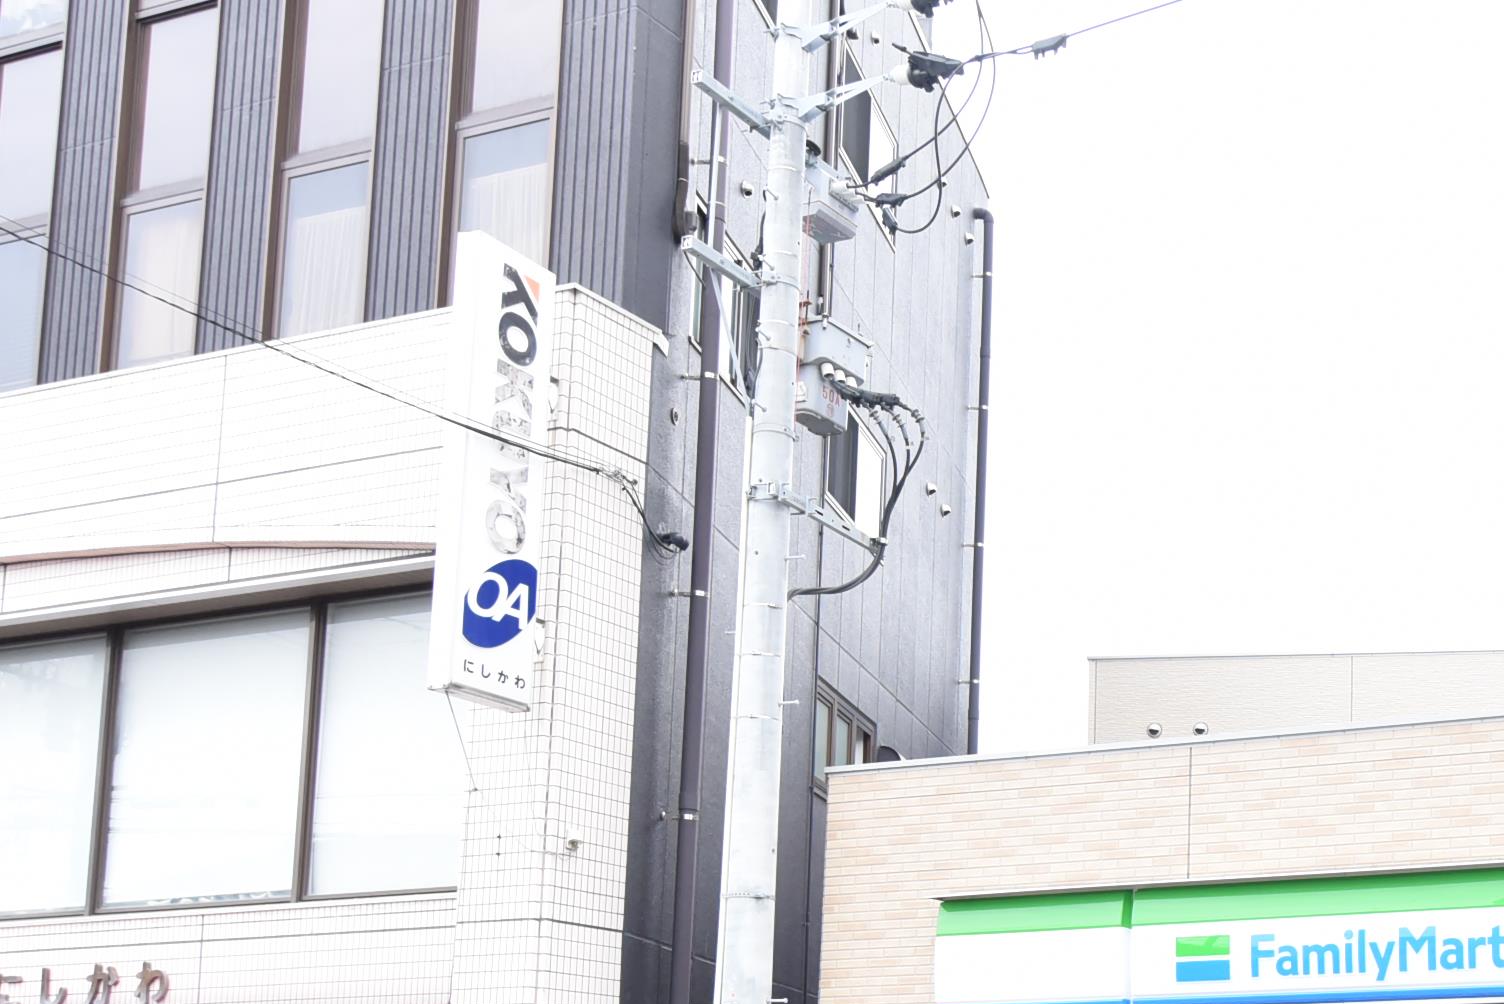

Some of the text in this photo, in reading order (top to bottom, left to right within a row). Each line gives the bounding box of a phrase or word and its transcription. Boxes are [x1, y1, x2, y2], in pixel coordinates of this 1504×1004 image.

[466, 571, 531, 631] OA
[463, 658, 527, 690] にしかわ
